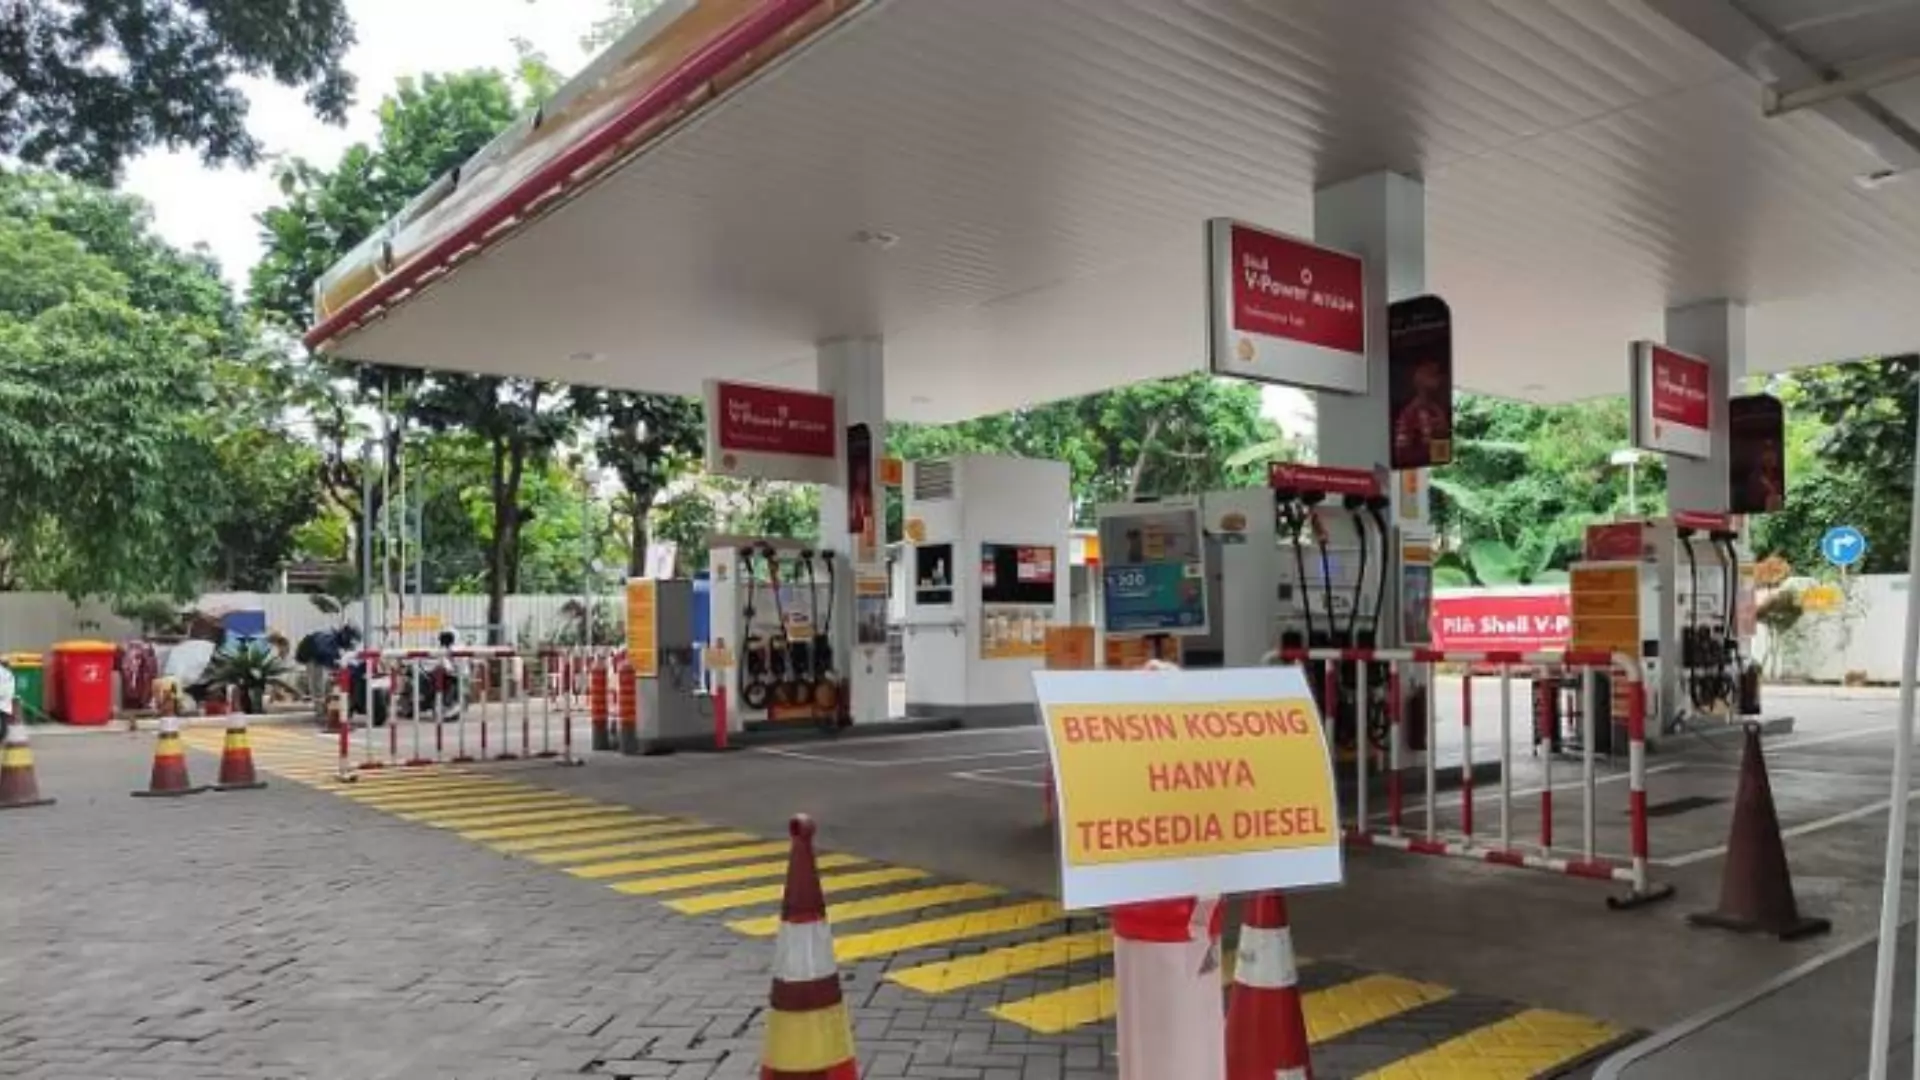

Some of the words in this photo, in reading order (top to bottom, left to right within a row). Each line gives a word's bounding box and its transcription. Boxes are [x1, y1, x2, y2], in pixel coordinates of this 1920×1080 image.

[1244, 267, 1309, 301] V-Power
[1479, 614, 1529, 633] Shell
[1062, 713, 1178, 743] BENSIN
[1183, 709, 1310, 739] KOSONG
[1148, 759, 1255, 792] HANYA
[1076, 812, 1224, 851] TERSEDIA
[1233, 807, 1326, 840] DIESEL
